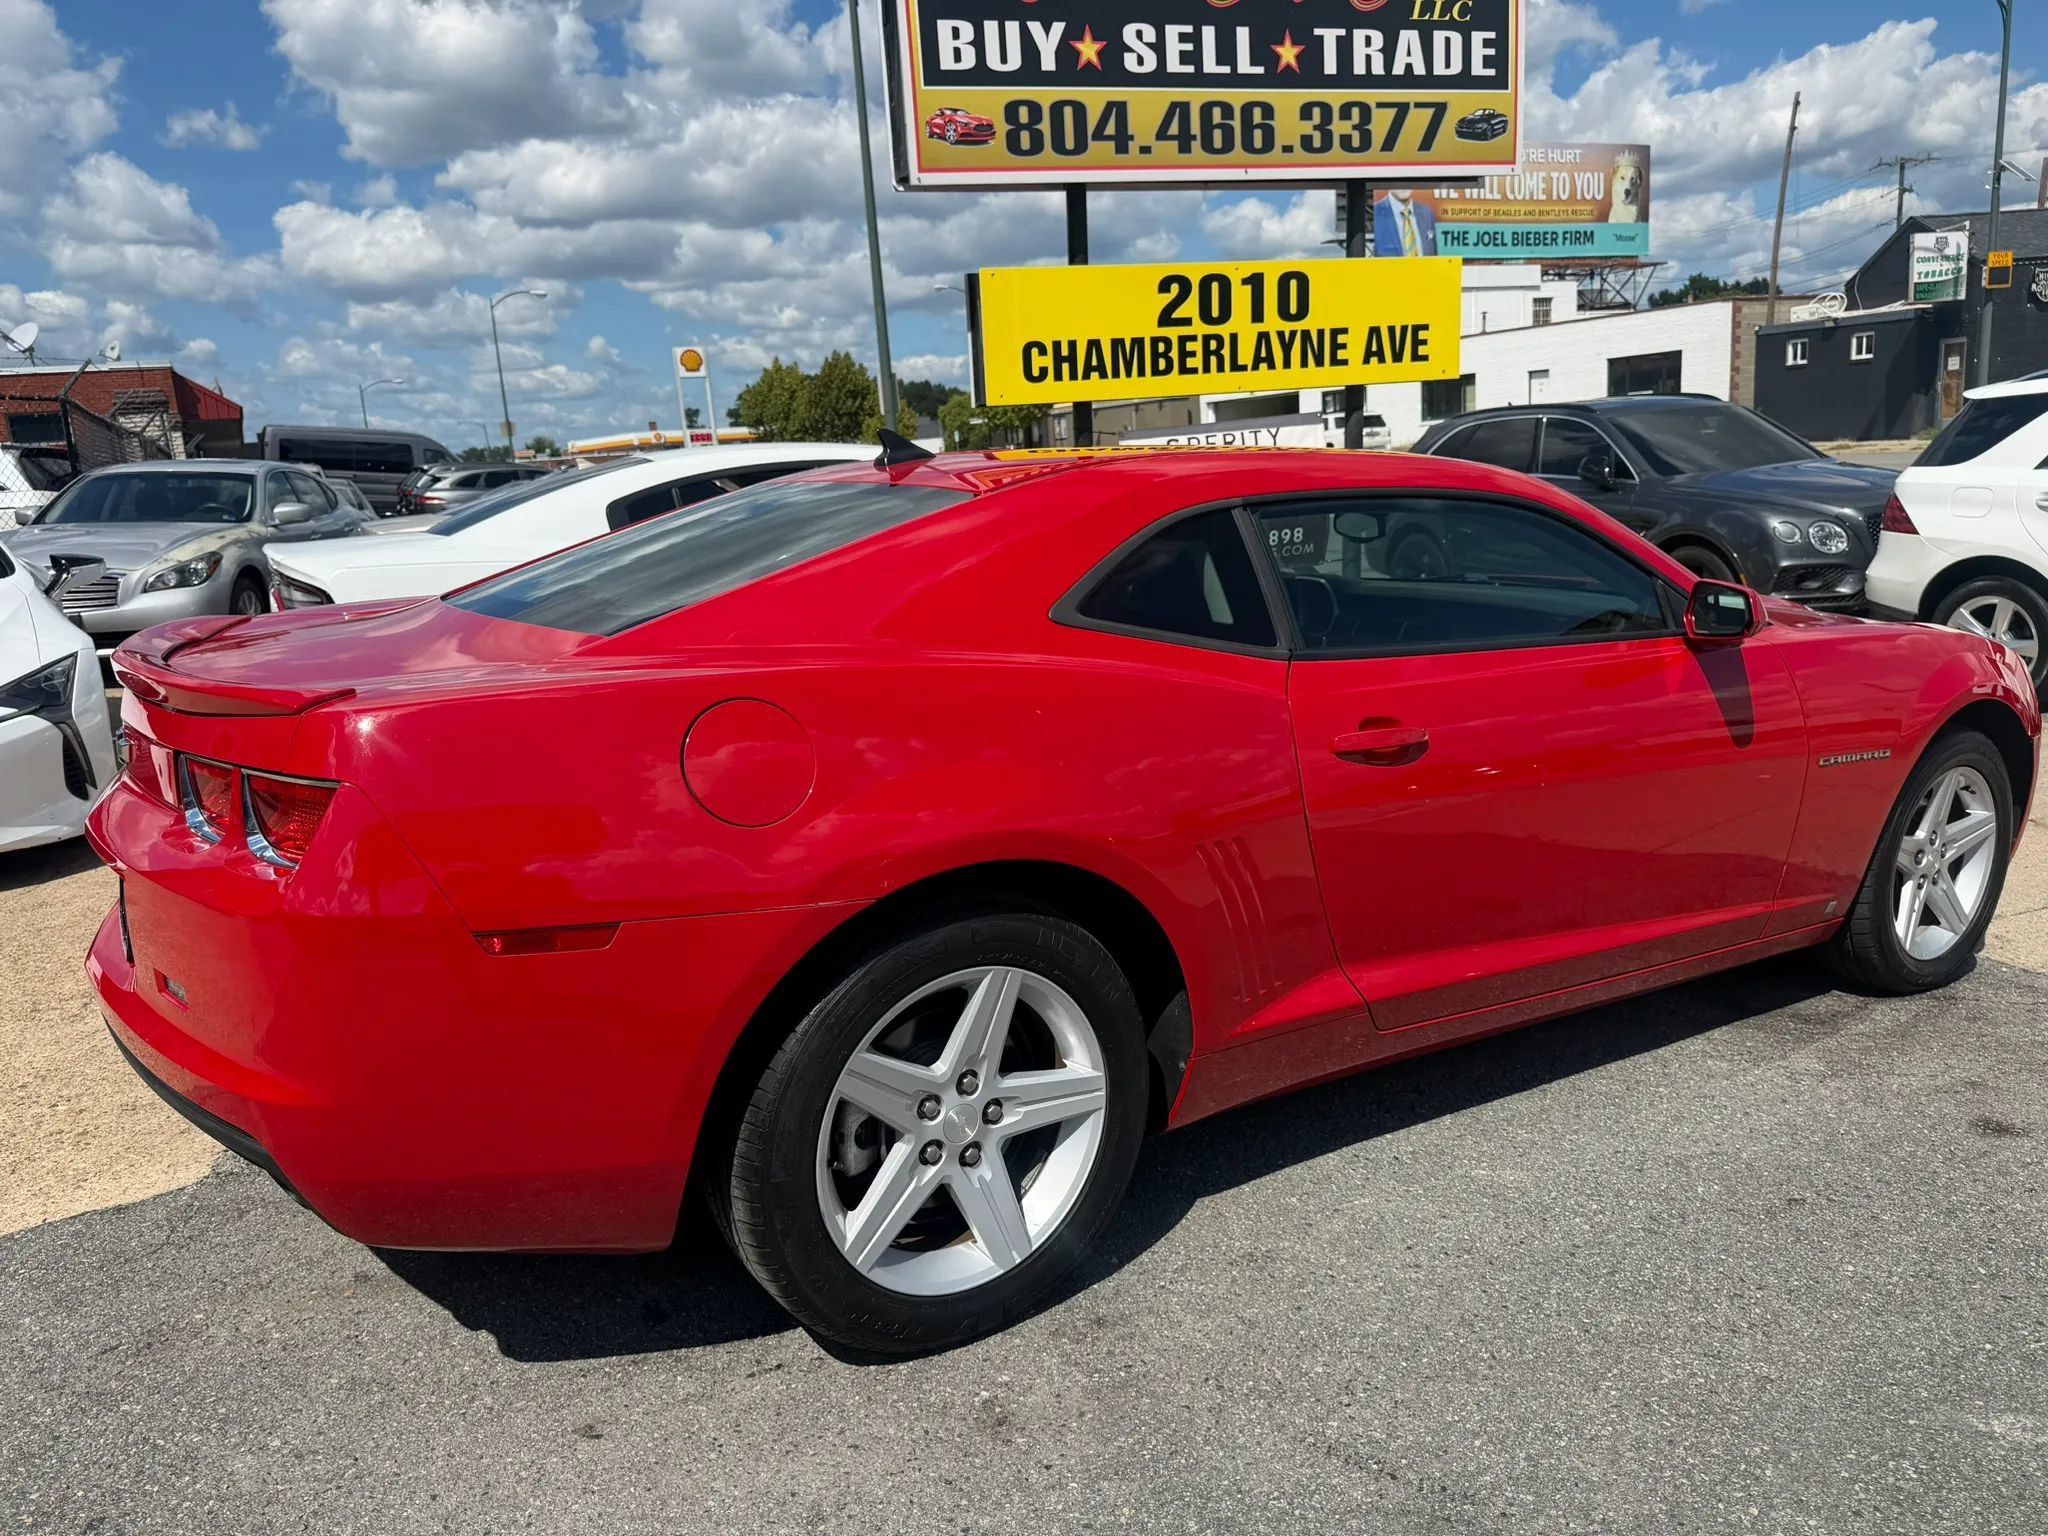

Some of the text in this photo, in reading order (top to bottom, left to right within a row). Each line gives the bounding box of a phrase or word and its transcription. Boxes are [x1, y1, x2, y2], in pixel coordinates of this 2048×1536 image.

[1407, 0, 1472, 21] LLC
[937, 19, 1496, 77] BUY SELL TRADE
[1003, 98, 1450, 157] 804.466.3377
[1548, 149, 1582, 163] HURT
[1504, 172, 1547, 200] COME
[1550, 172, 1571, 200] TO
[1573, 172, 1605, 200] YOU
[1441, 208, 1449, 217] IN
[1450, 208, 1482, 217] SUPPORT
[1483, 208, 1492, 217] OF
[1493, 208, 1522, 217] BEAGLES
[1523, 208, 1536, 217] AND
[1571, 207, 1595, 217] RESCUE
[1441, 230, 1595, 247] THE JOEL BIEBER FIRM
[1917, 267, 1964, 280] TOBACCO
[1156, 270, 1310, 328] 2010
[1021, 323, 1431, 384] CHAMBERLAYNE AVE
[1269, 527, 1304, 546] 898
[1819, 749, 1891, 765] CAMARO
